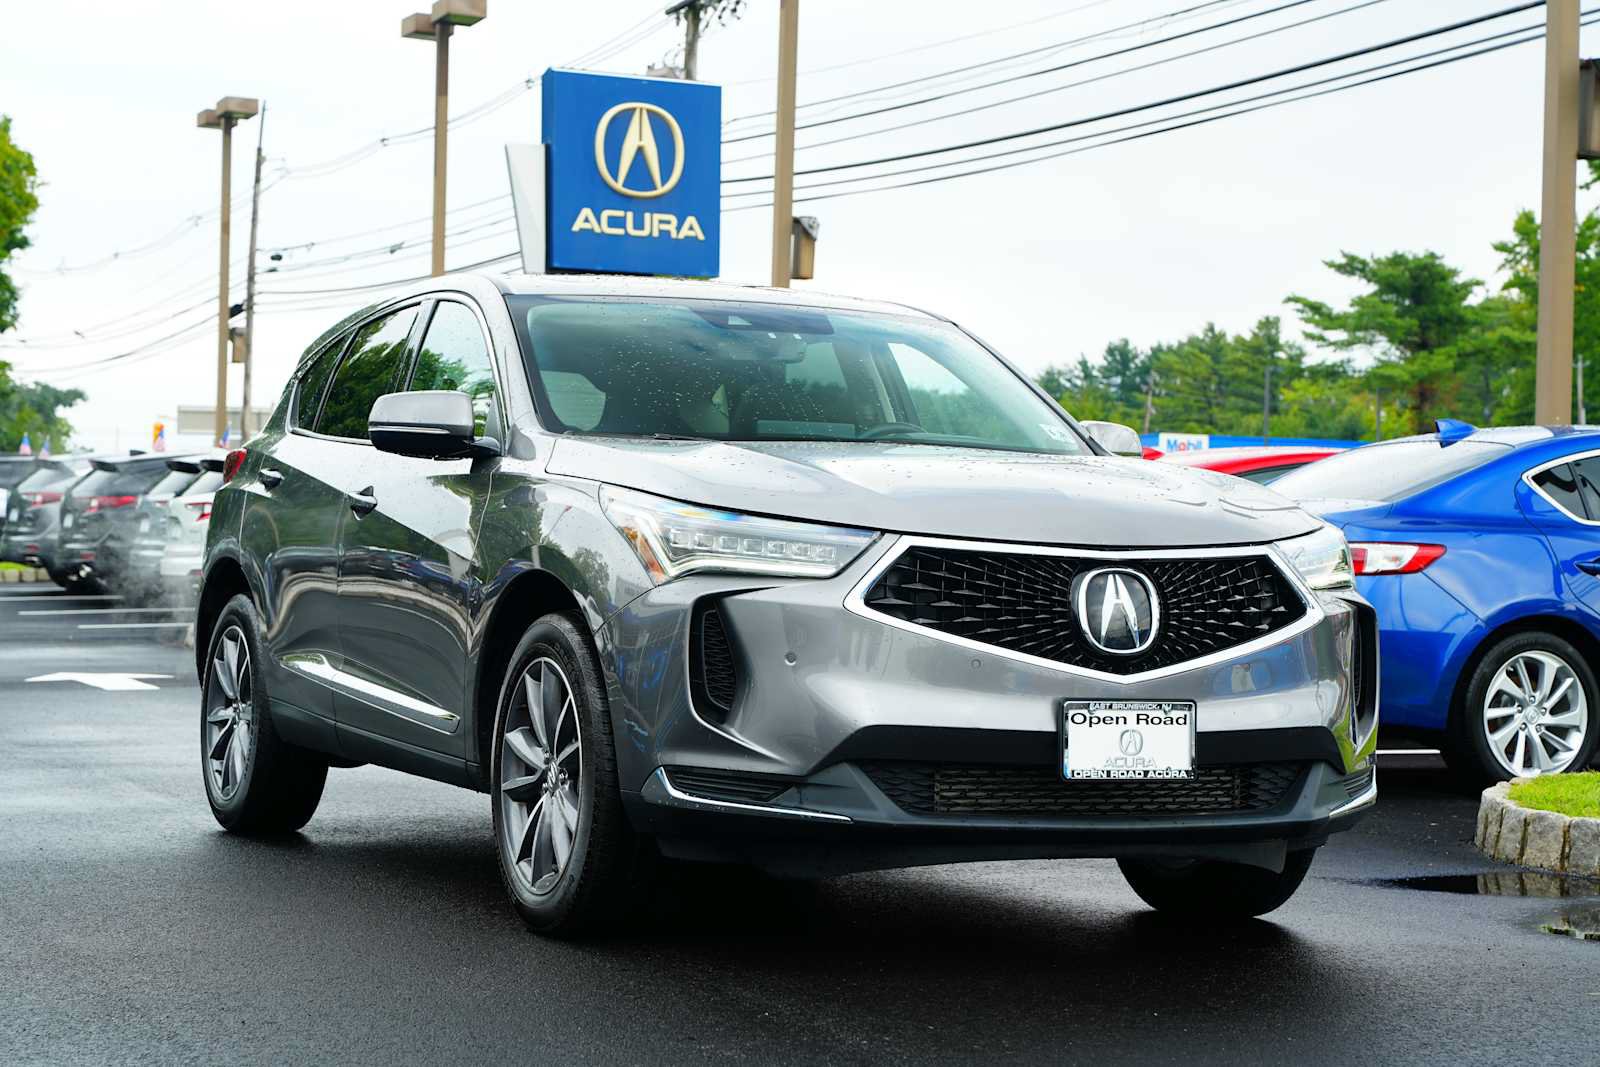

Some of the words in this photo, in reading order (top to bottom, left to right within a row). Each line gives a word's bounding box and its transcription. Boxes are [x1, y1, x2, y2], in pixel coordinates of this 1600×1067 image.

[571, 207, 705, 240] ACURA
[1089, 703, 1110, 711] EAST
[1162, 703, 1172, 711] NJ
[1070, 712, 1127, 728] Open
[1136, 713, 1187, 726] Road
[1104, 757, 1158, 769] ACURA
[1074, 770, 1107, 779] OPEN
[1111, 770, 1144, 779] ROAD
[1147, 770, 1188, 779] ACURA
